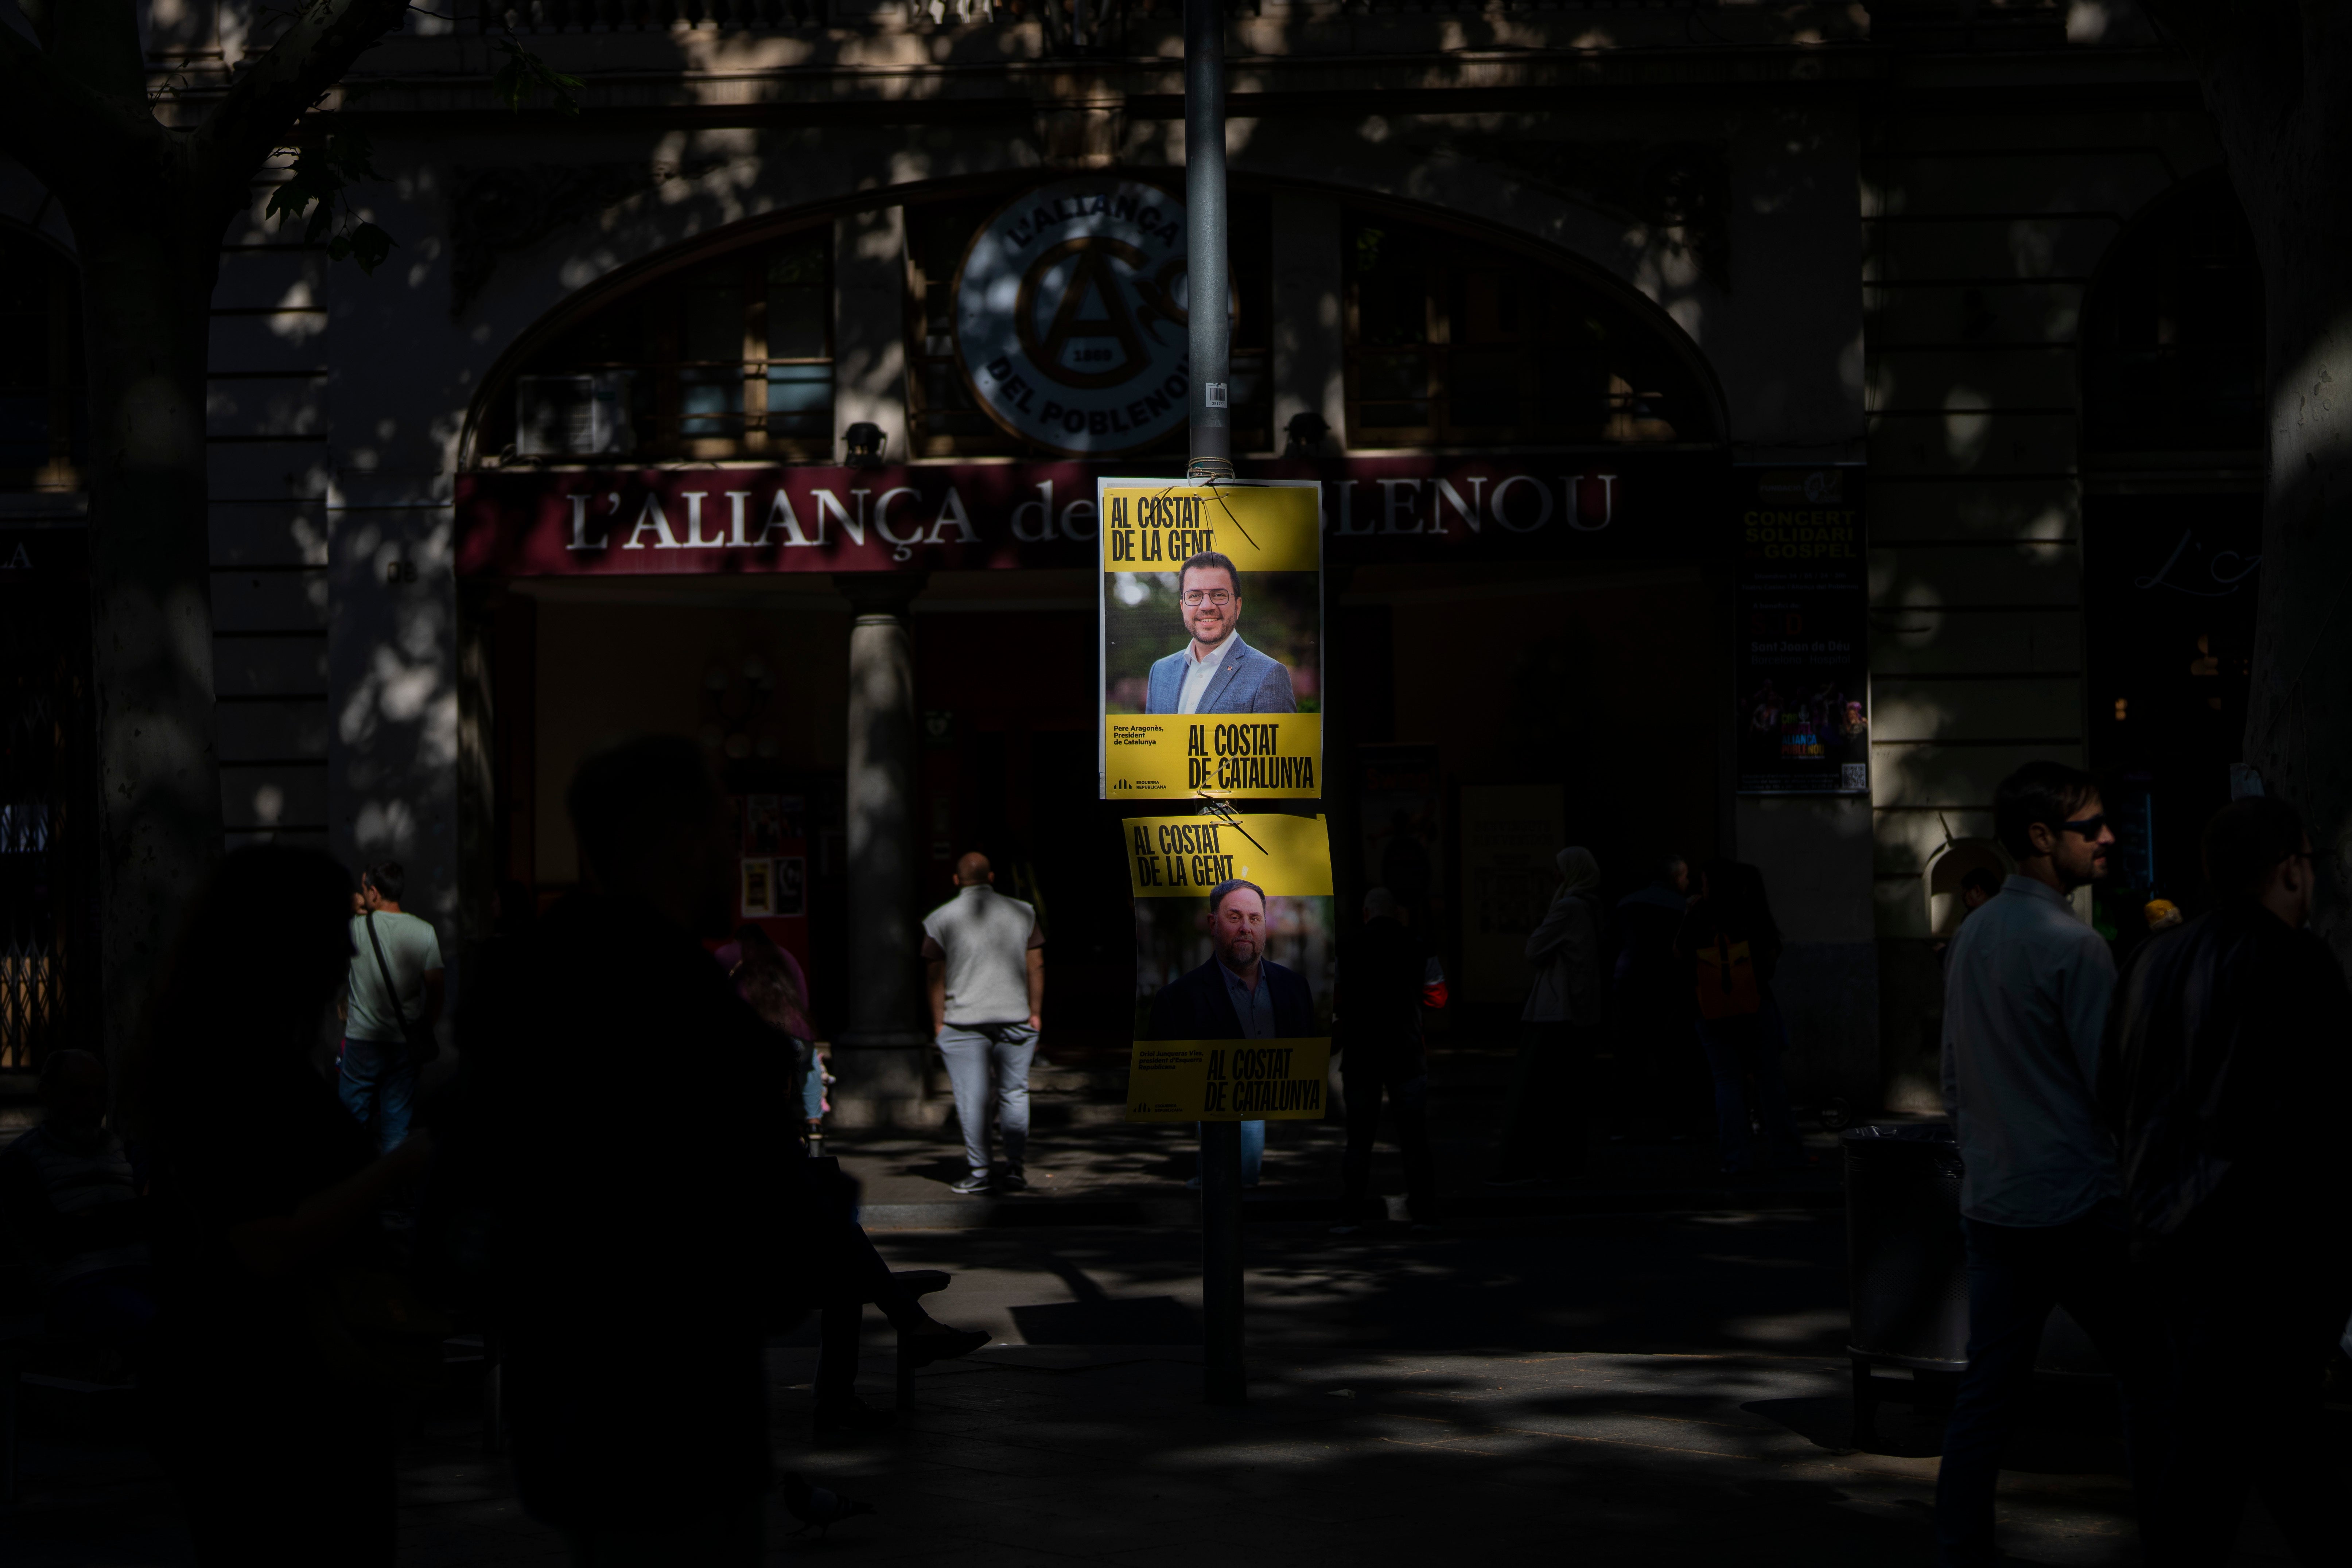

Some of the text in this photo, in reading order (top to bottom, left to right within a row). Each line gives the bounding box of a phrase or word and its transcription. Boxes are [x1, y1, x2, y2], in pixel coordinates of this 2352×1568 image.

[1007, 193, 1181, 249] L'ALIANÇA
[1074, 350, 1112, 361] 1869
[987, 355, 1190, 435] DEL POBLENO
[565, 473, 1618, 562] L'ALIANÇA de LENOU
[1111, 497, 1202, 529] AL COSTAT
[1744, 510, 1856, 526] CONCERT
[1112, 529, 1213, 561] DE LA GENT
[1745, 527, 1854, 543] SOLIDARI
[1764, 543, 1857, 559] GOSPEL
[1751, 612, 1803, 636] SJD
[1750, 639, 1850, 653] Sant Joan de Déu
[1751, 655, 1802, 665] Barcelona
[1809, 655, 1851, 666] Hospital
[1123, 739, 1156, 747] Catalunya
[1131, 725, 1164, 733] Aragonès,
[1187, 724, 1279, 756] AL COSTAT
[1189, 756, 1314, 790] DE CATALUNYA
[1133, 824, 1220, 856] AL COSTAT
[1137, 855, 1234, 887] DE LA GENT
[1155, 1050, 1188, 1058] Junqueras
[1206, 1048, 1293, 1081] AL COSTAT
[1204, 1079, 1320, 1112] DE CATALUNYA
